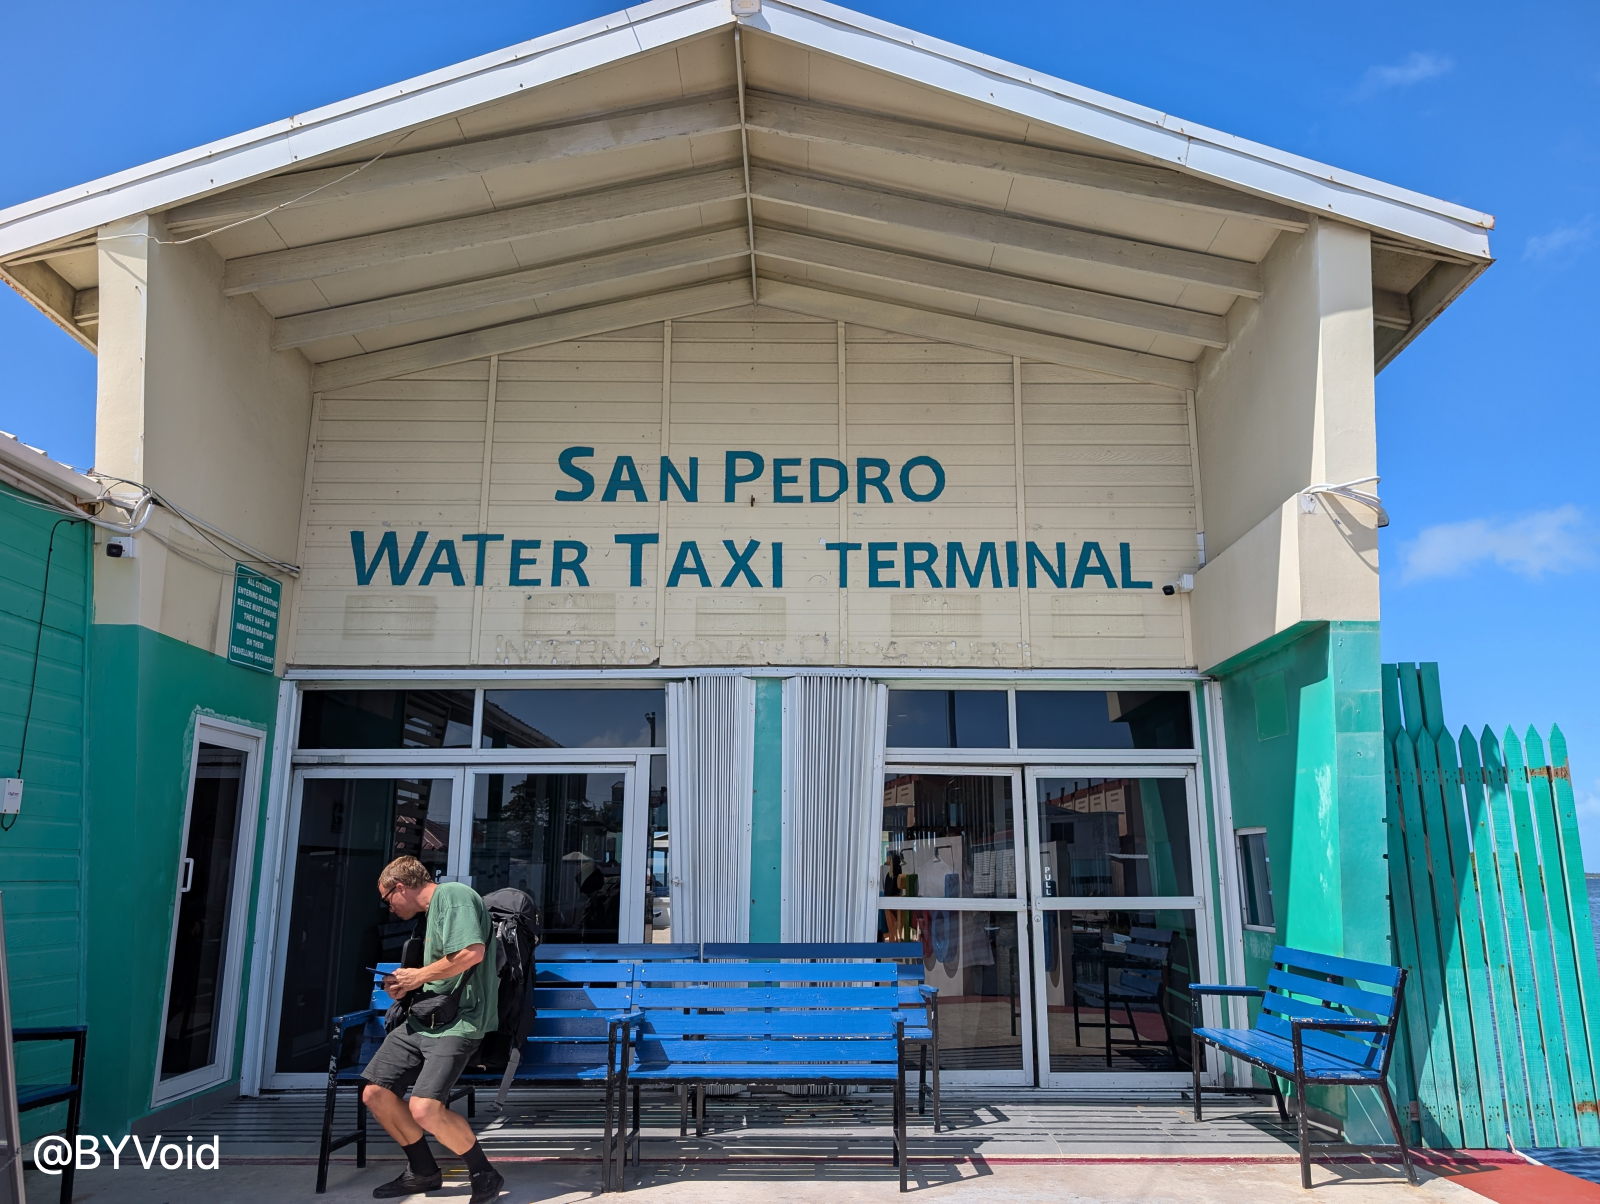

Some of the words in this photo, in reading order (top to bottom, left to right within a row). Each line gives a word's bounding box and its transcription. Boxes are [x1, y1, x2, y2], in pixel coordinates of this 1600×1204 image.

[555, 446, 698, 503] SAN
[724, 450, 946, 503] PEDRO
[350, 530, 590, 587] WATER
[614, 533, 783, 588] TAXI
[825, 541, 1153, 588] TERMINAL
[256, 581, 272, 594] CITIZENS
[238, 586, 258, 600] ENTERING
[264, 597, 278, 608] EXITING
[237, 598, 252, 610] BELIZE
[252, 604, 263, 614] MUST
[243, 613, 254, 622] THEY
[255, 617, 264, 626] HAVE
[236, 622, 262, 637] IMMIGRATION
[263, 632, 274, 641] STAMP
[246, 638, 252, 646] ON
[232, 646, 254, 659] TRAVELLING
